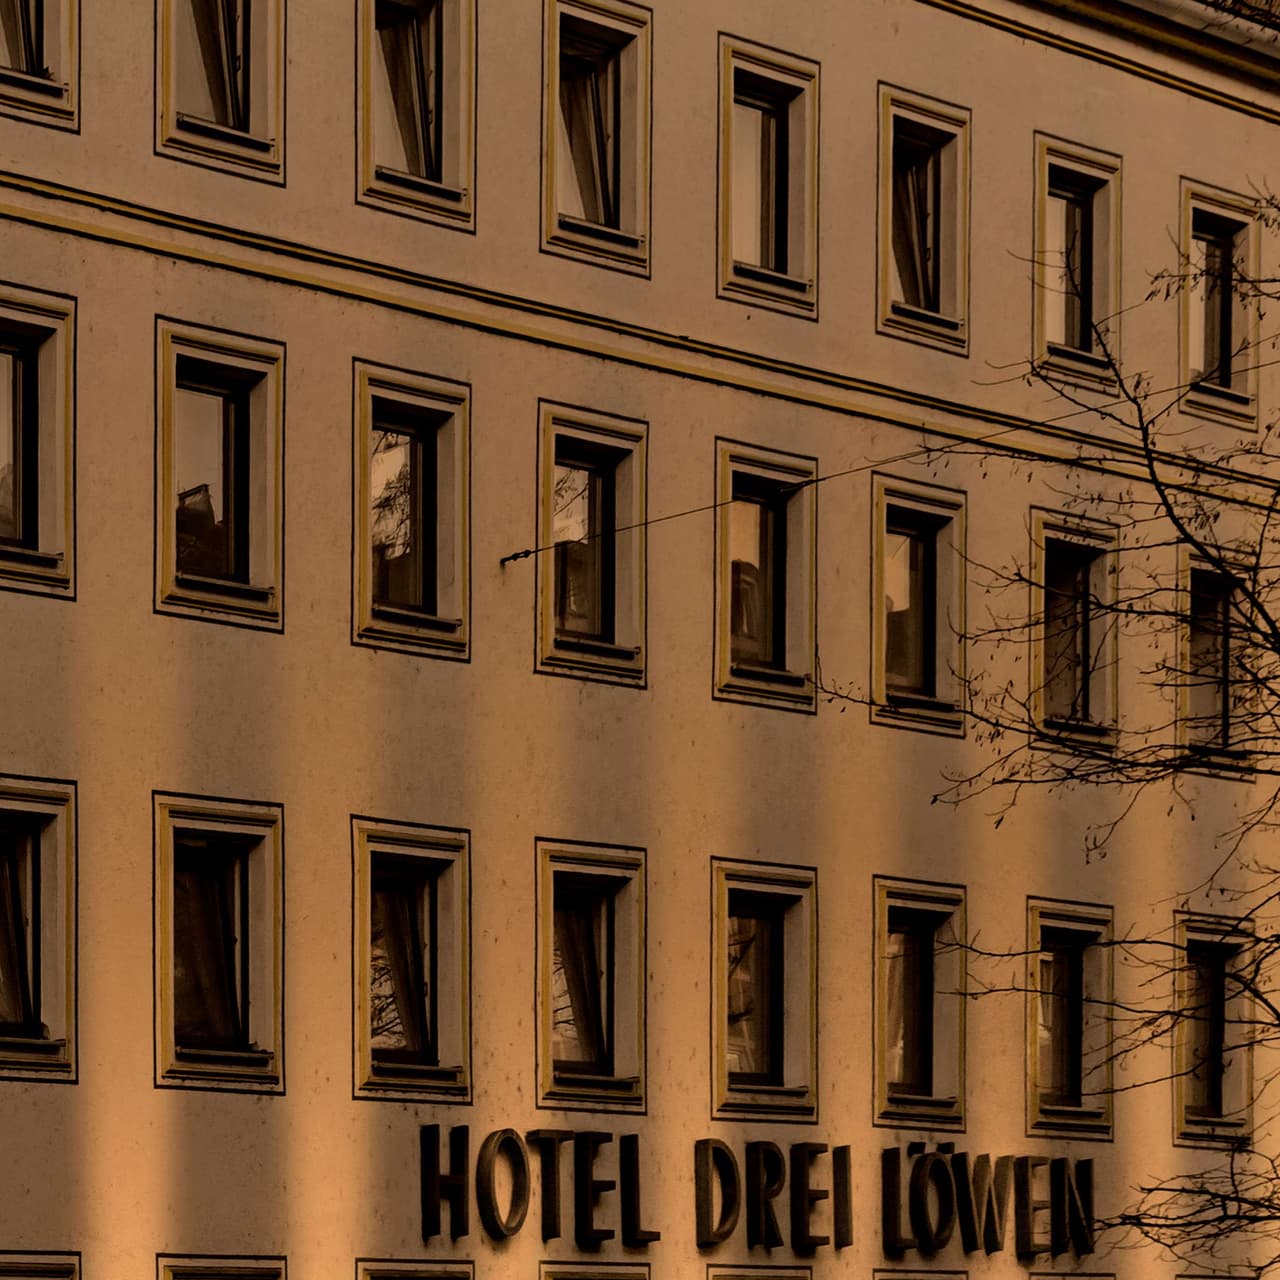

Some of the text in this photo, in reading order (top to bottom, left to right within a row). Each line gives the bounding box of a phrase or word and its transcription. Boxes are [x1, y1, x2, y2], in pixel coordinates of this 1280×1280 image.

[419, 1123, 1096, 1263] HOTEL DREI LÖWEN
